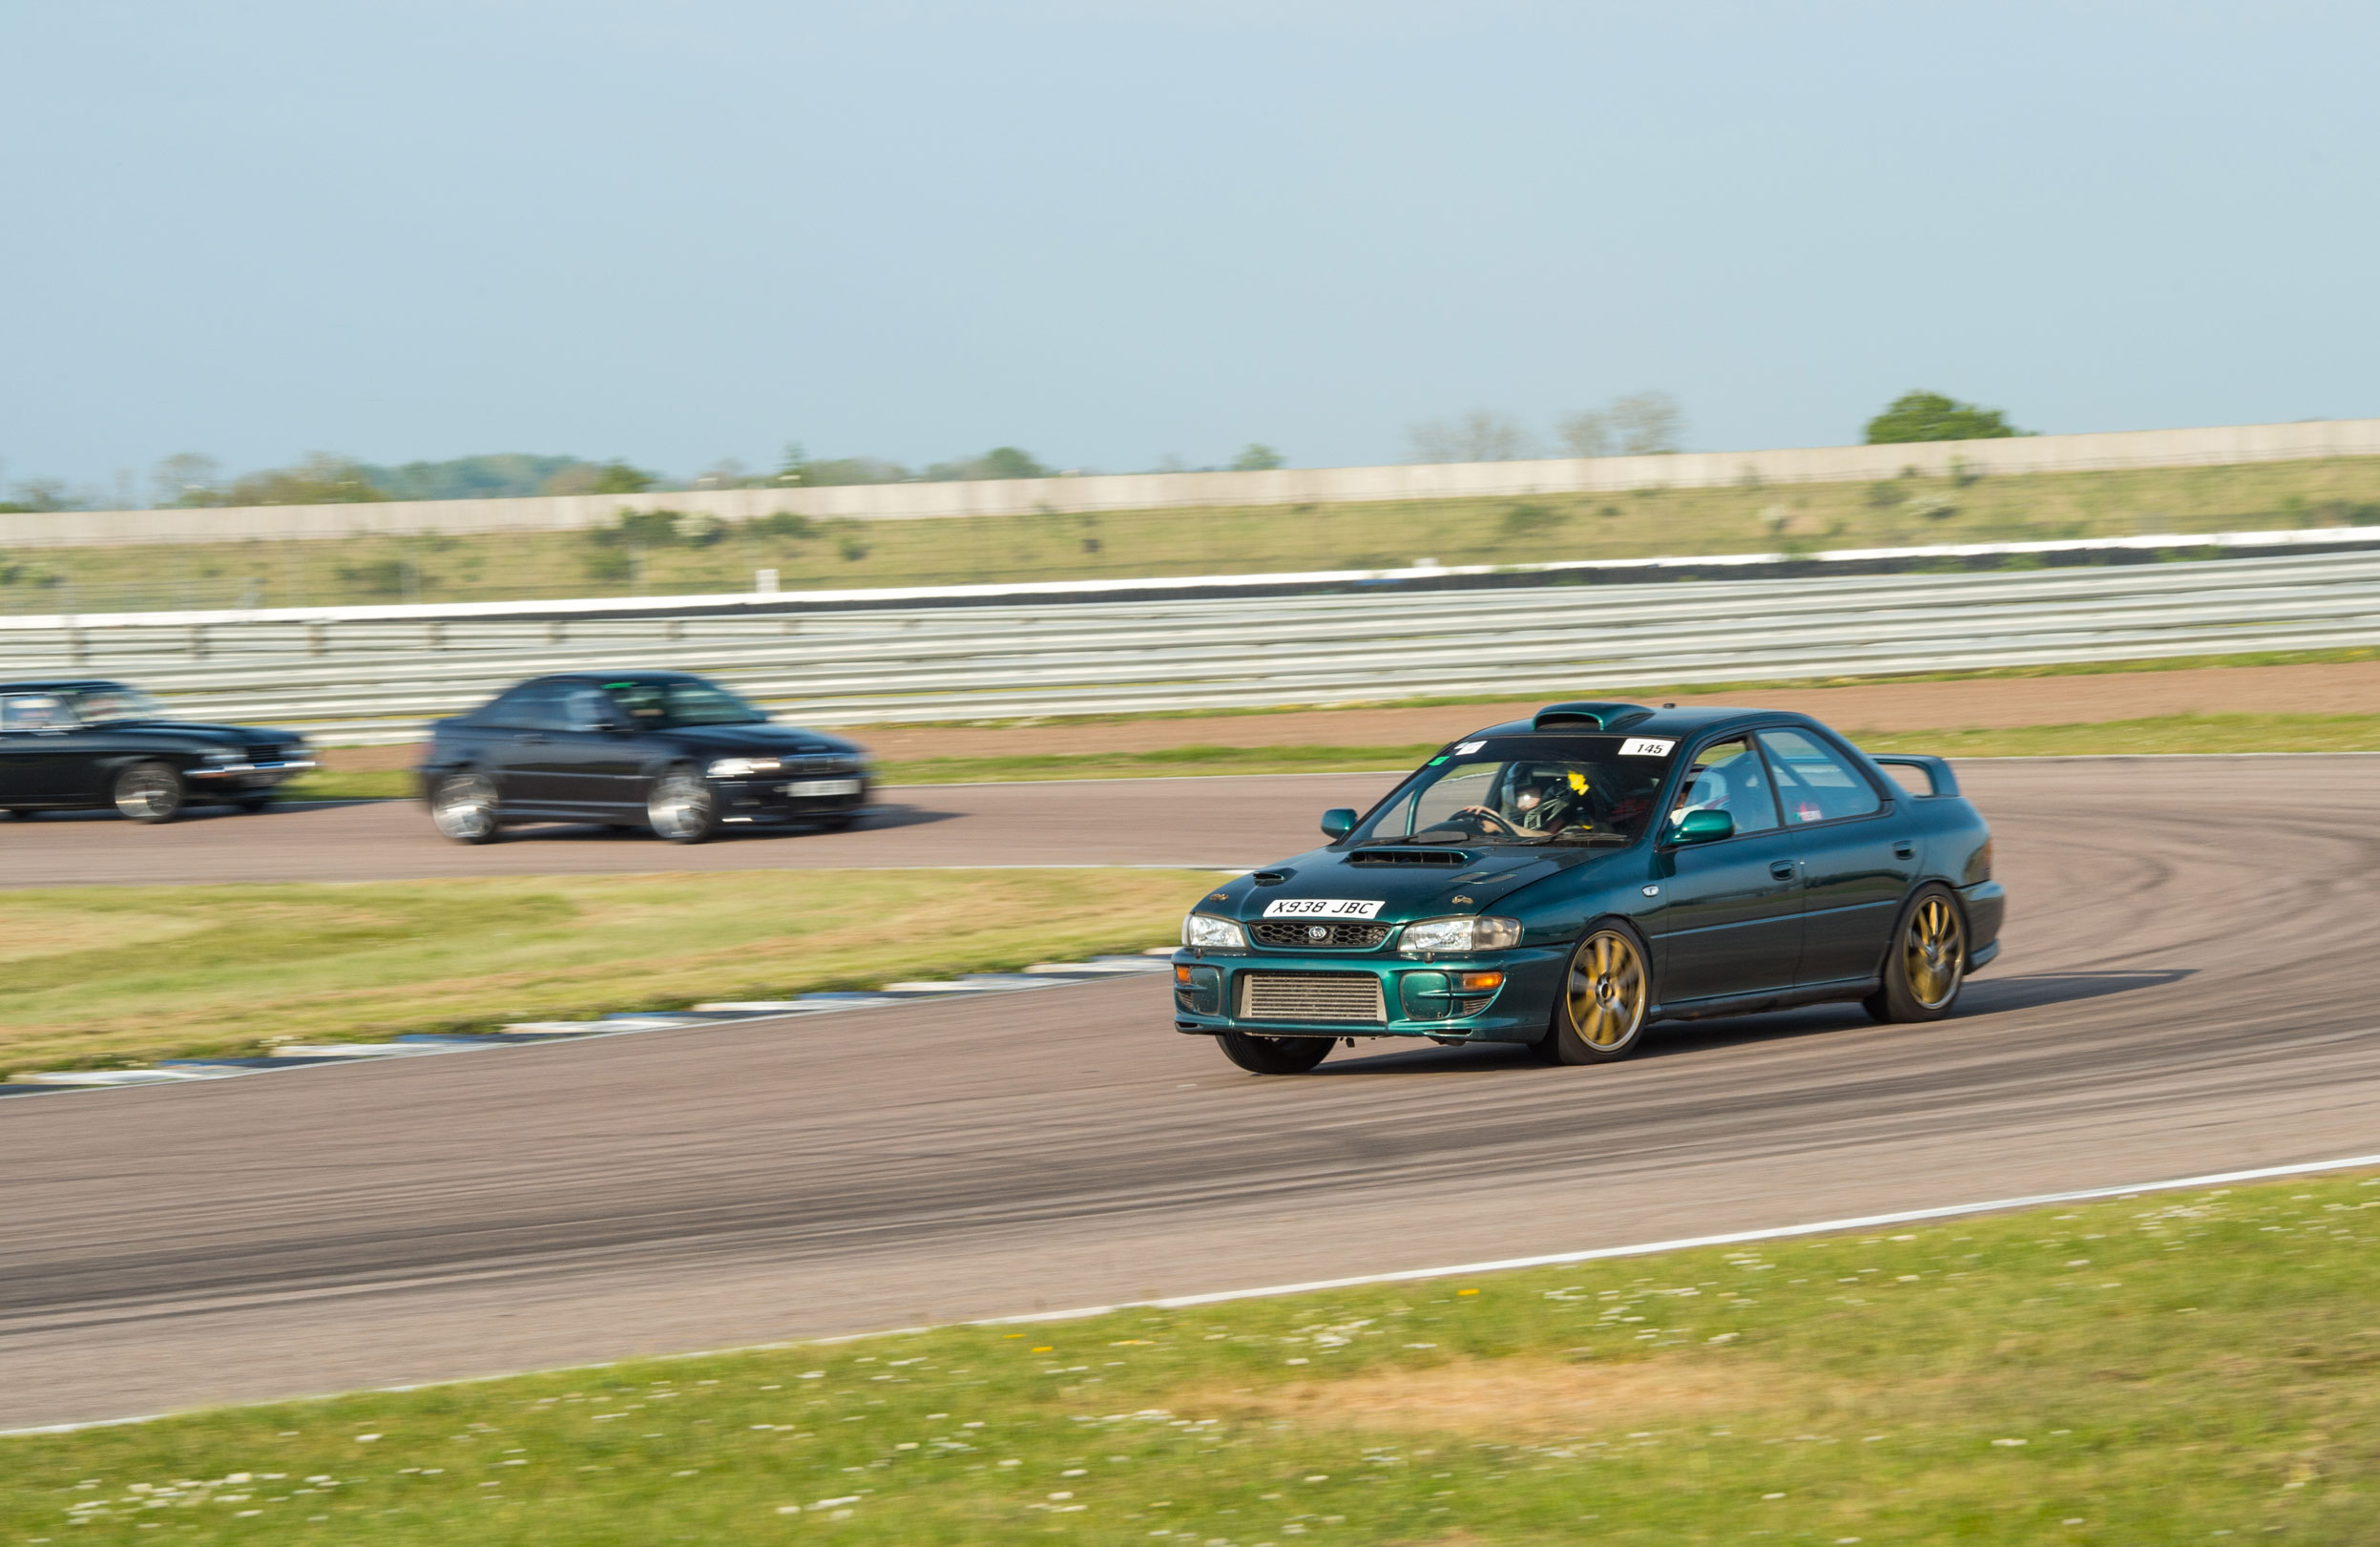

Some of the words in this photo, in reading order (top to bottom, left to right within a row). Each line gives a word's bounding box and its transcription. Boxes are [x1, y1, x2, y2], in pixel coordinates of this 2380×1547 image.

[1637, 743, 1665, 755] 145
[1272, 901, 1327, 913] X938
[1330, 901, 1374, 914] JBC
